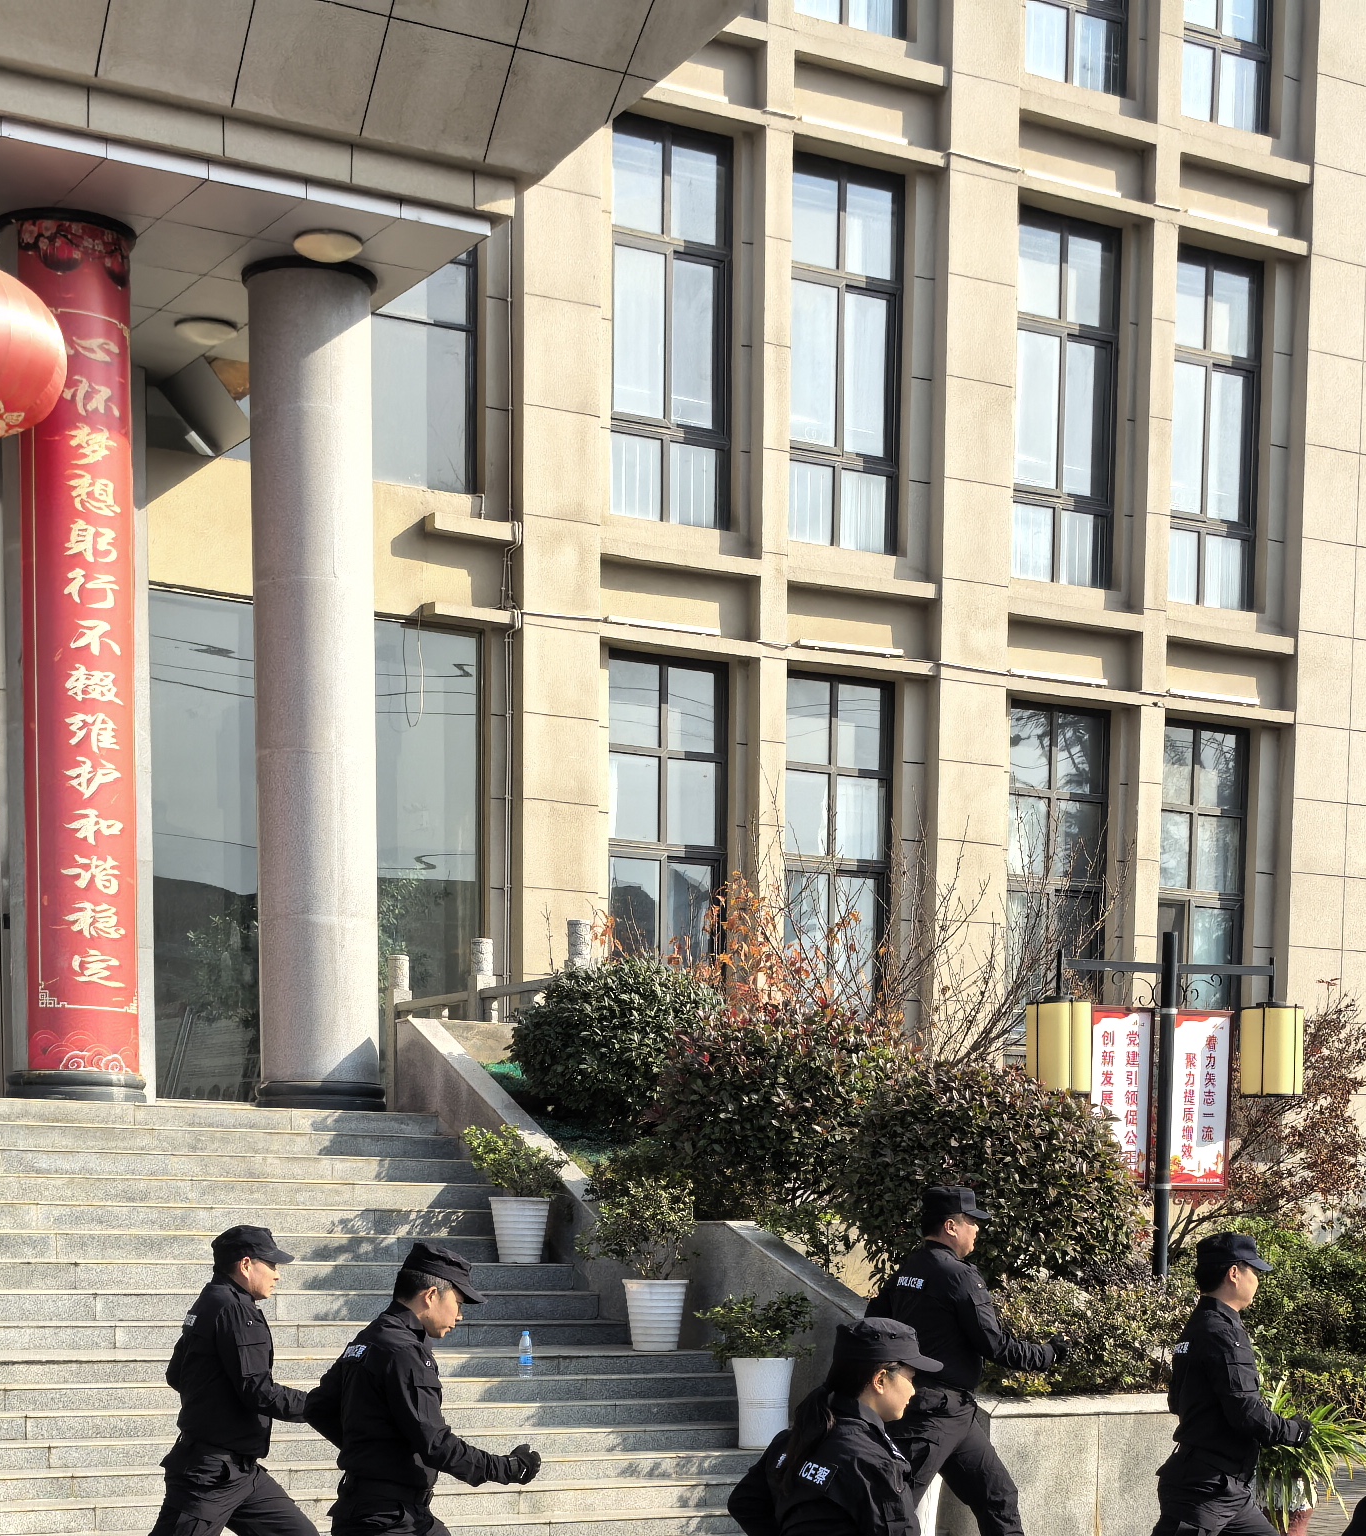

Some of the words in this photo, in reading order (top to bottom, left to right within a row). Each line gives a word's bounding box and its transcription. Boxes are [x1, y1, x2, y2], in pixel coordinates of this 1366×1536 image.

[1101, 1030, 1115, 1107] 创新发展
[1181, 1052, 1198, 1159] 聚力提质增效
